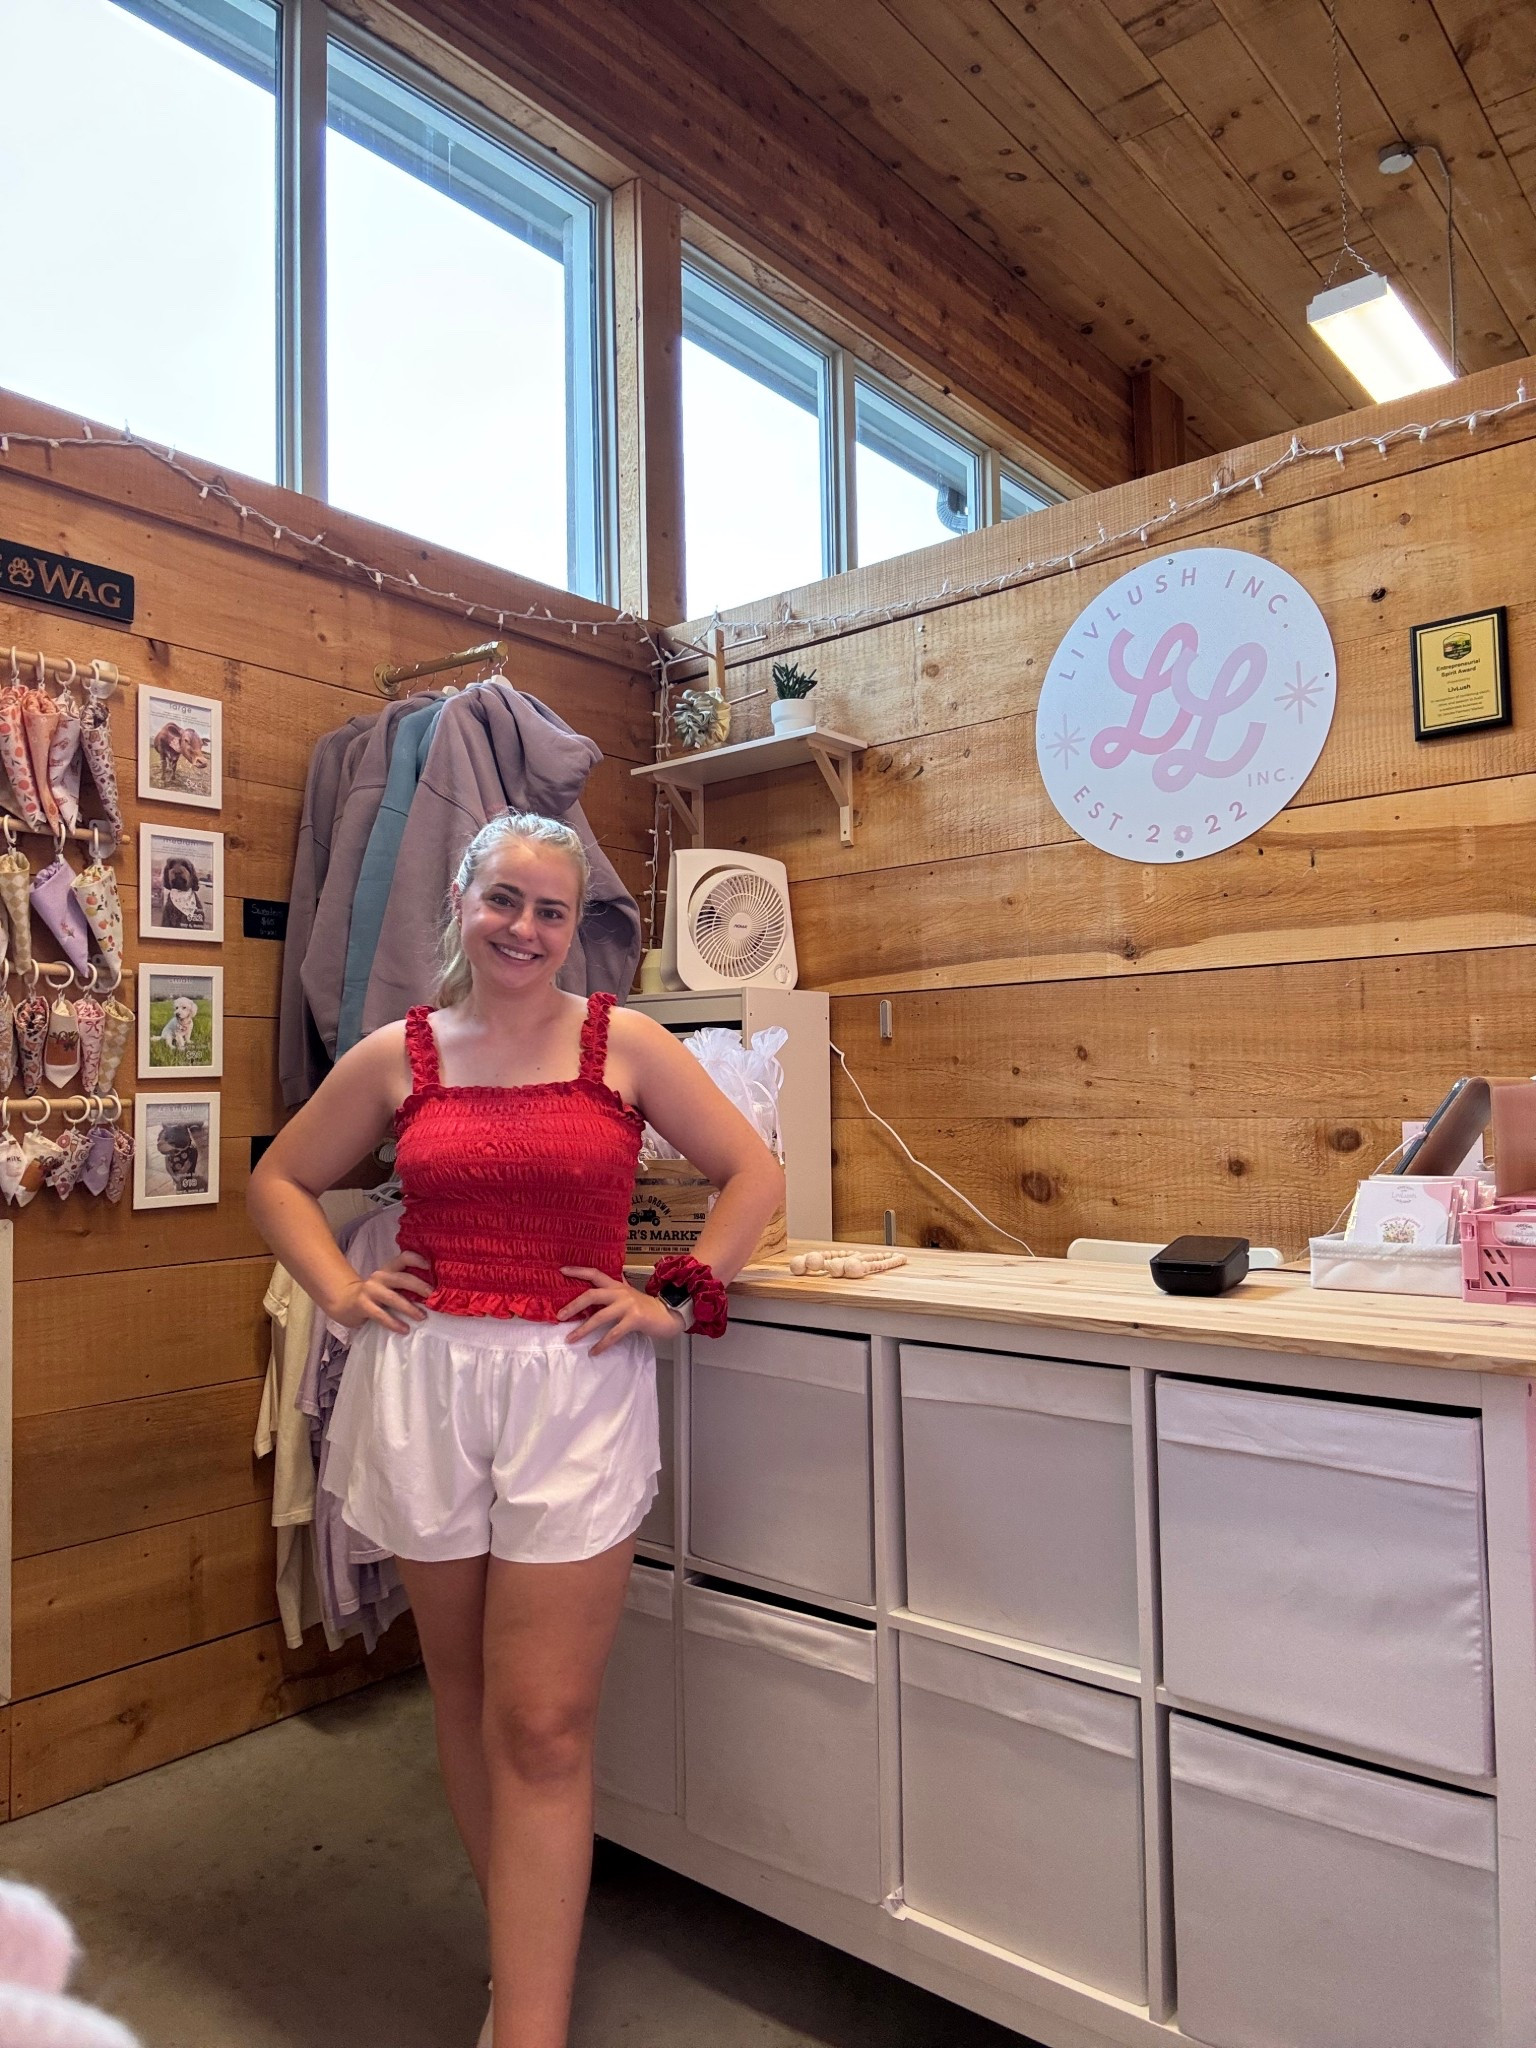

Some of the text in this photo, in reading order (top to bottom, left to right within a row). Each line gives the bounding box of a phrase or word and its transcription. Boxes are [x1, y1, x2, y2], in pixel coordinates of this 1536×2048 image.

[33, 557, 122, 608] WAG
[1059, 567, 1289, 681] LIVLUSH INC.
[1436, 658, 1481, 672] Entrepreneurial
[1441, 665, 1477, 678] Spirit Award
[1247, 767, 1295, 788] INC.
[627, 1229, 648, 1241] R'S
